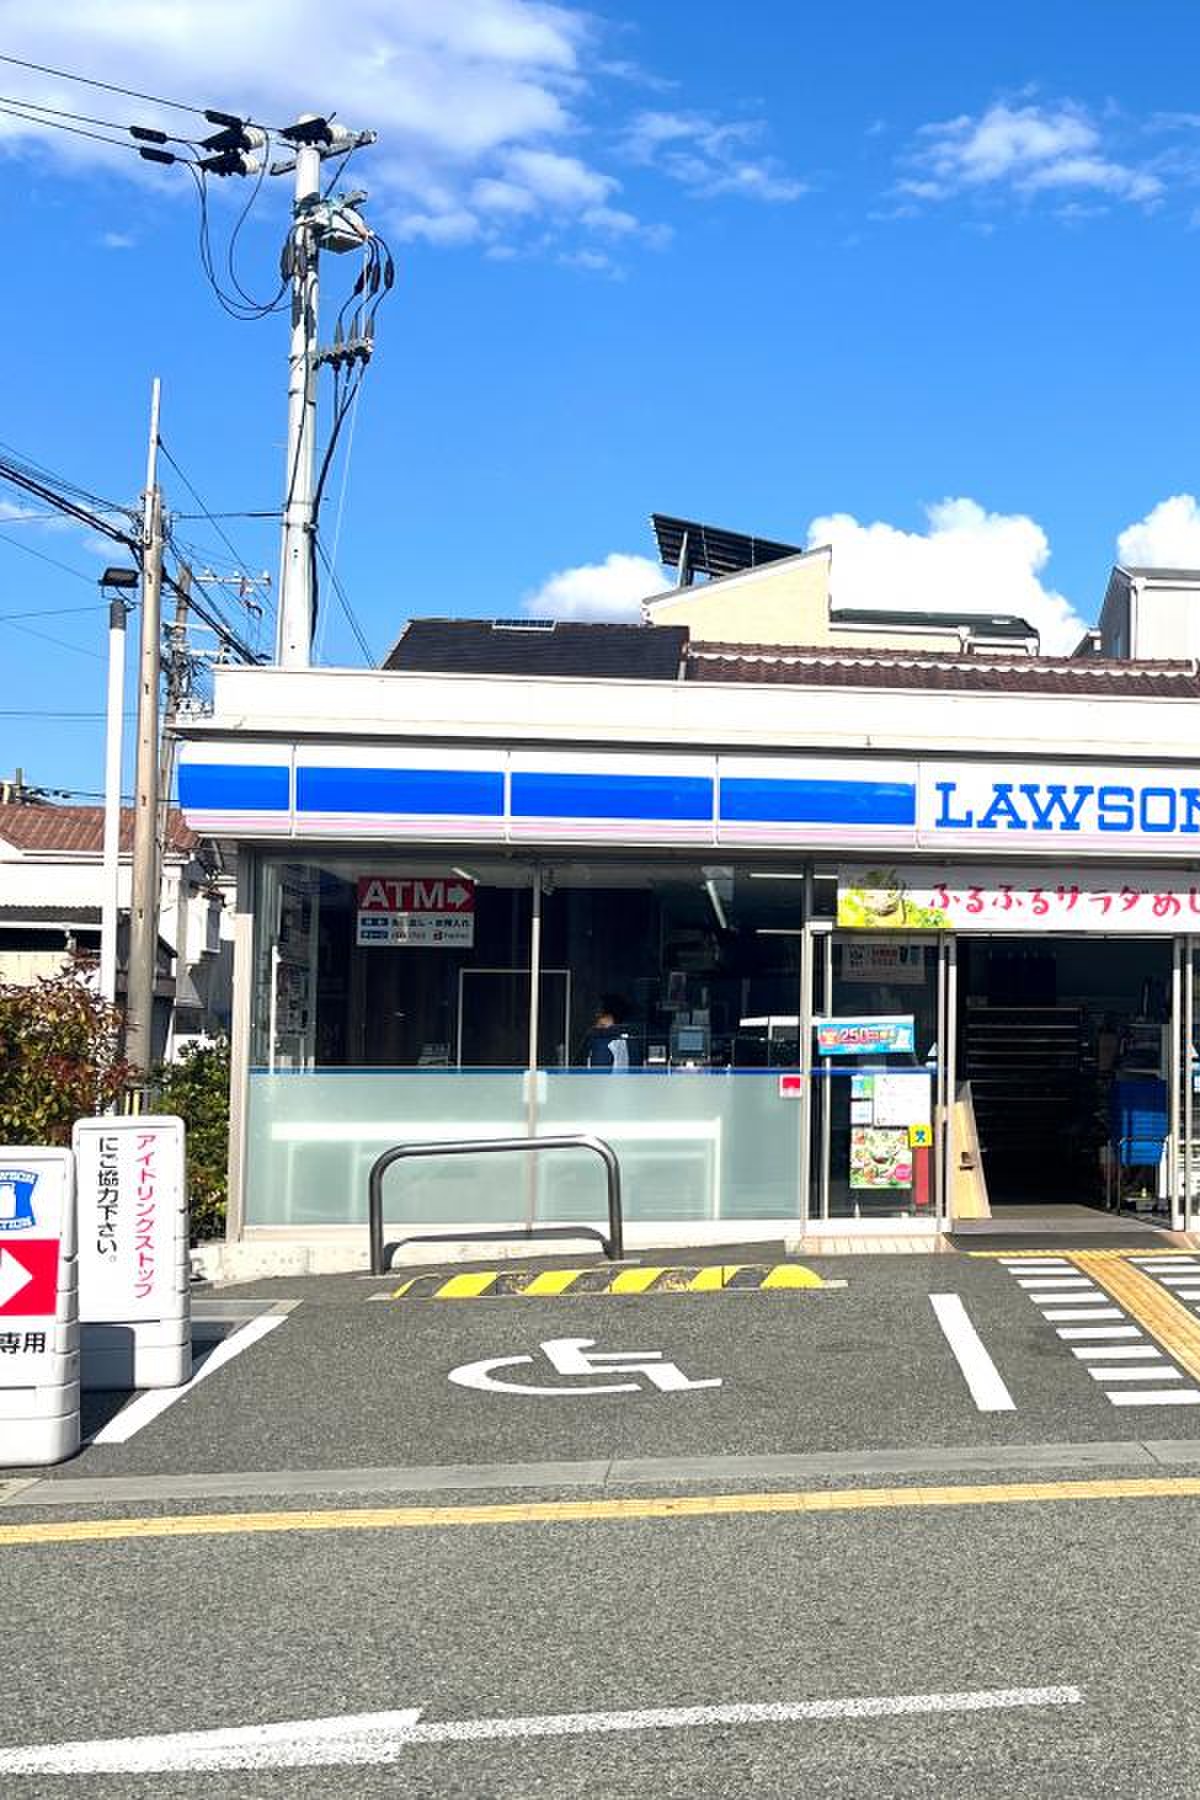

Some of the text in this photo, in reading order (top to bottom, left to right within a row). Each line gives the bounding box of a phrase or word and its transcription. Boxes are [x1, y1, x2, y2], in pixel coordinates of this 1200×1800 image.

[361, 881, 445, 908] ATM
[97, 1136, 119, 1263] にご協力下さい。
[134, 1134, 157, 1299] アイドリングストップ
[0, 1332, 46, 1353] 専用
